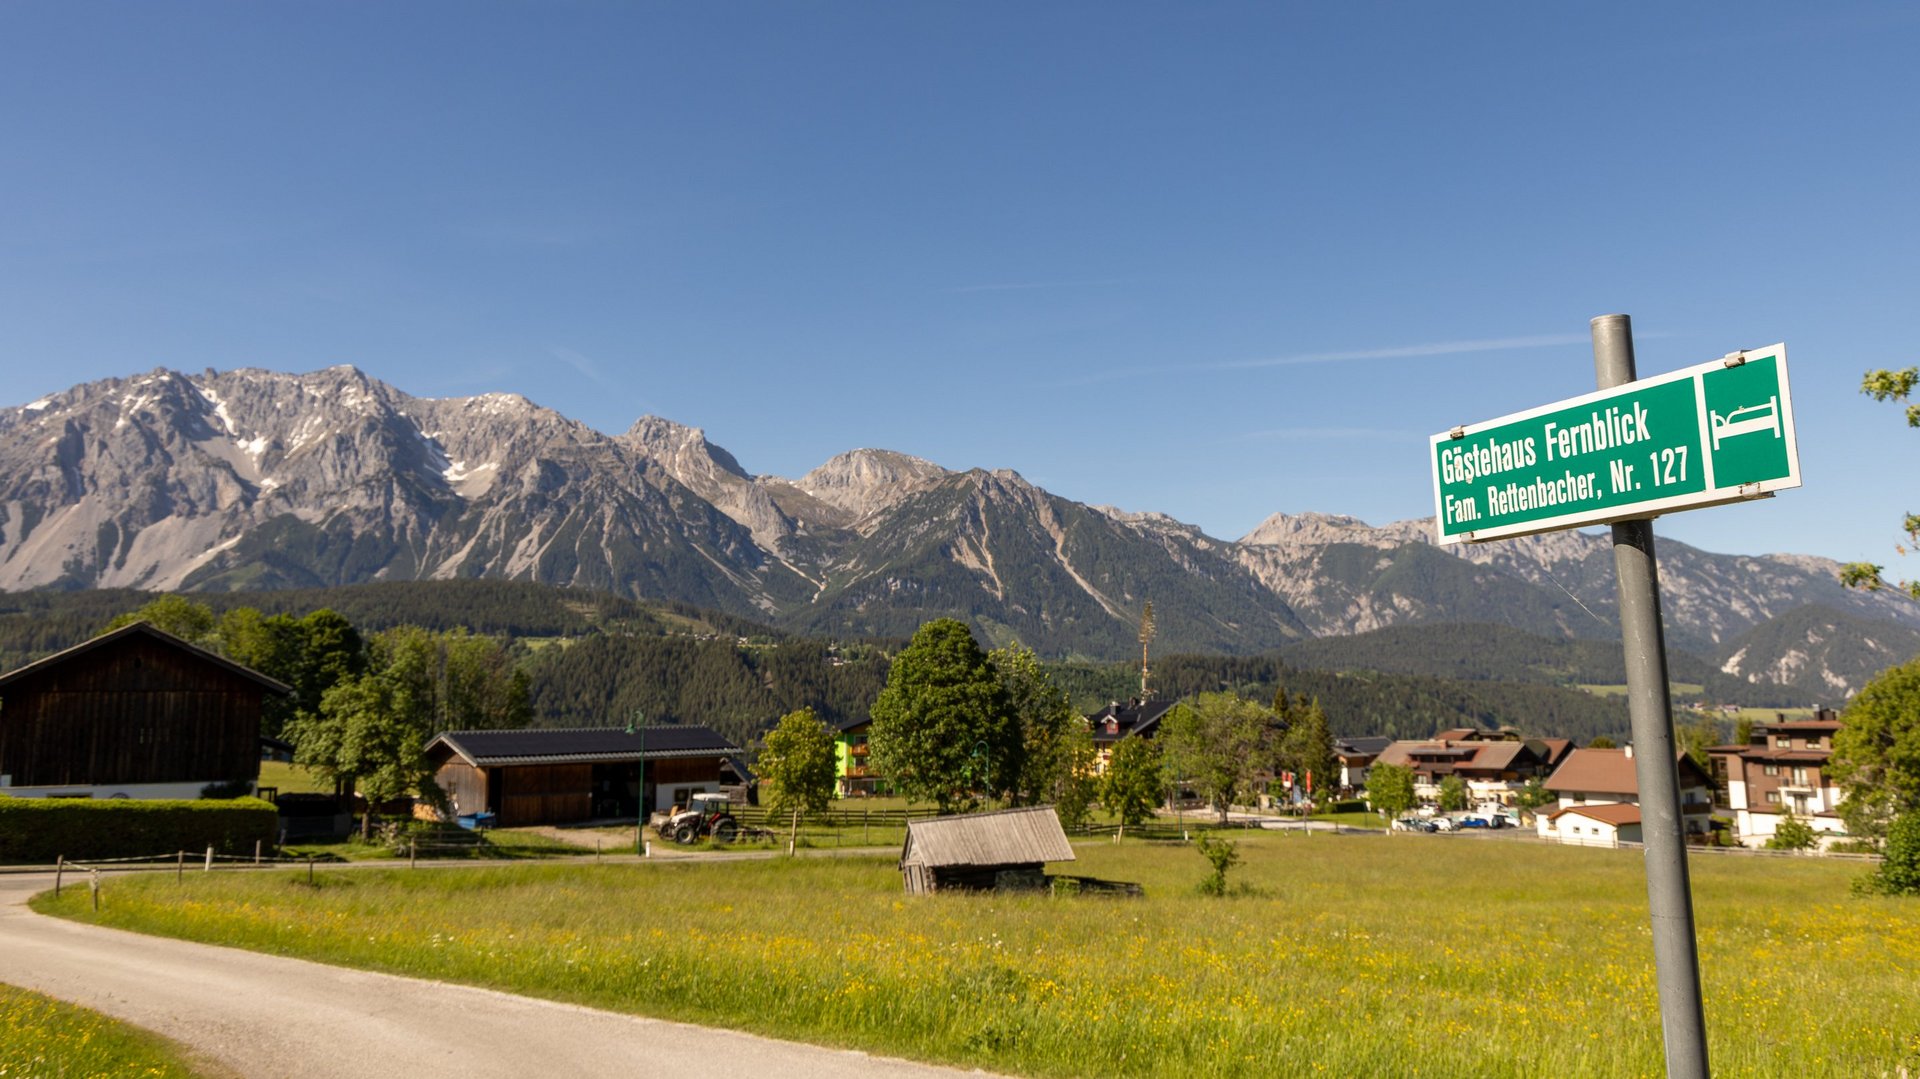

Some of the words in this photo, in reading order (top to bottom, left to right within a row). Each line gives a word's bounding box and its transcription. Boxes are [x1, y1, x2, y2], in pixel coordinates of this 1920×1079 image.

[1441, 436, 1536, 485] Gästehaus
[1544, 401, 1651, 462] Fernblick
[1445, 494, 1481, 525] Fam.
[1488, 470, 1602, 517] Rettenbacher,
[1610, 458, 1641, 493] Nr.
[1650, 446, 1688, 487] 127
